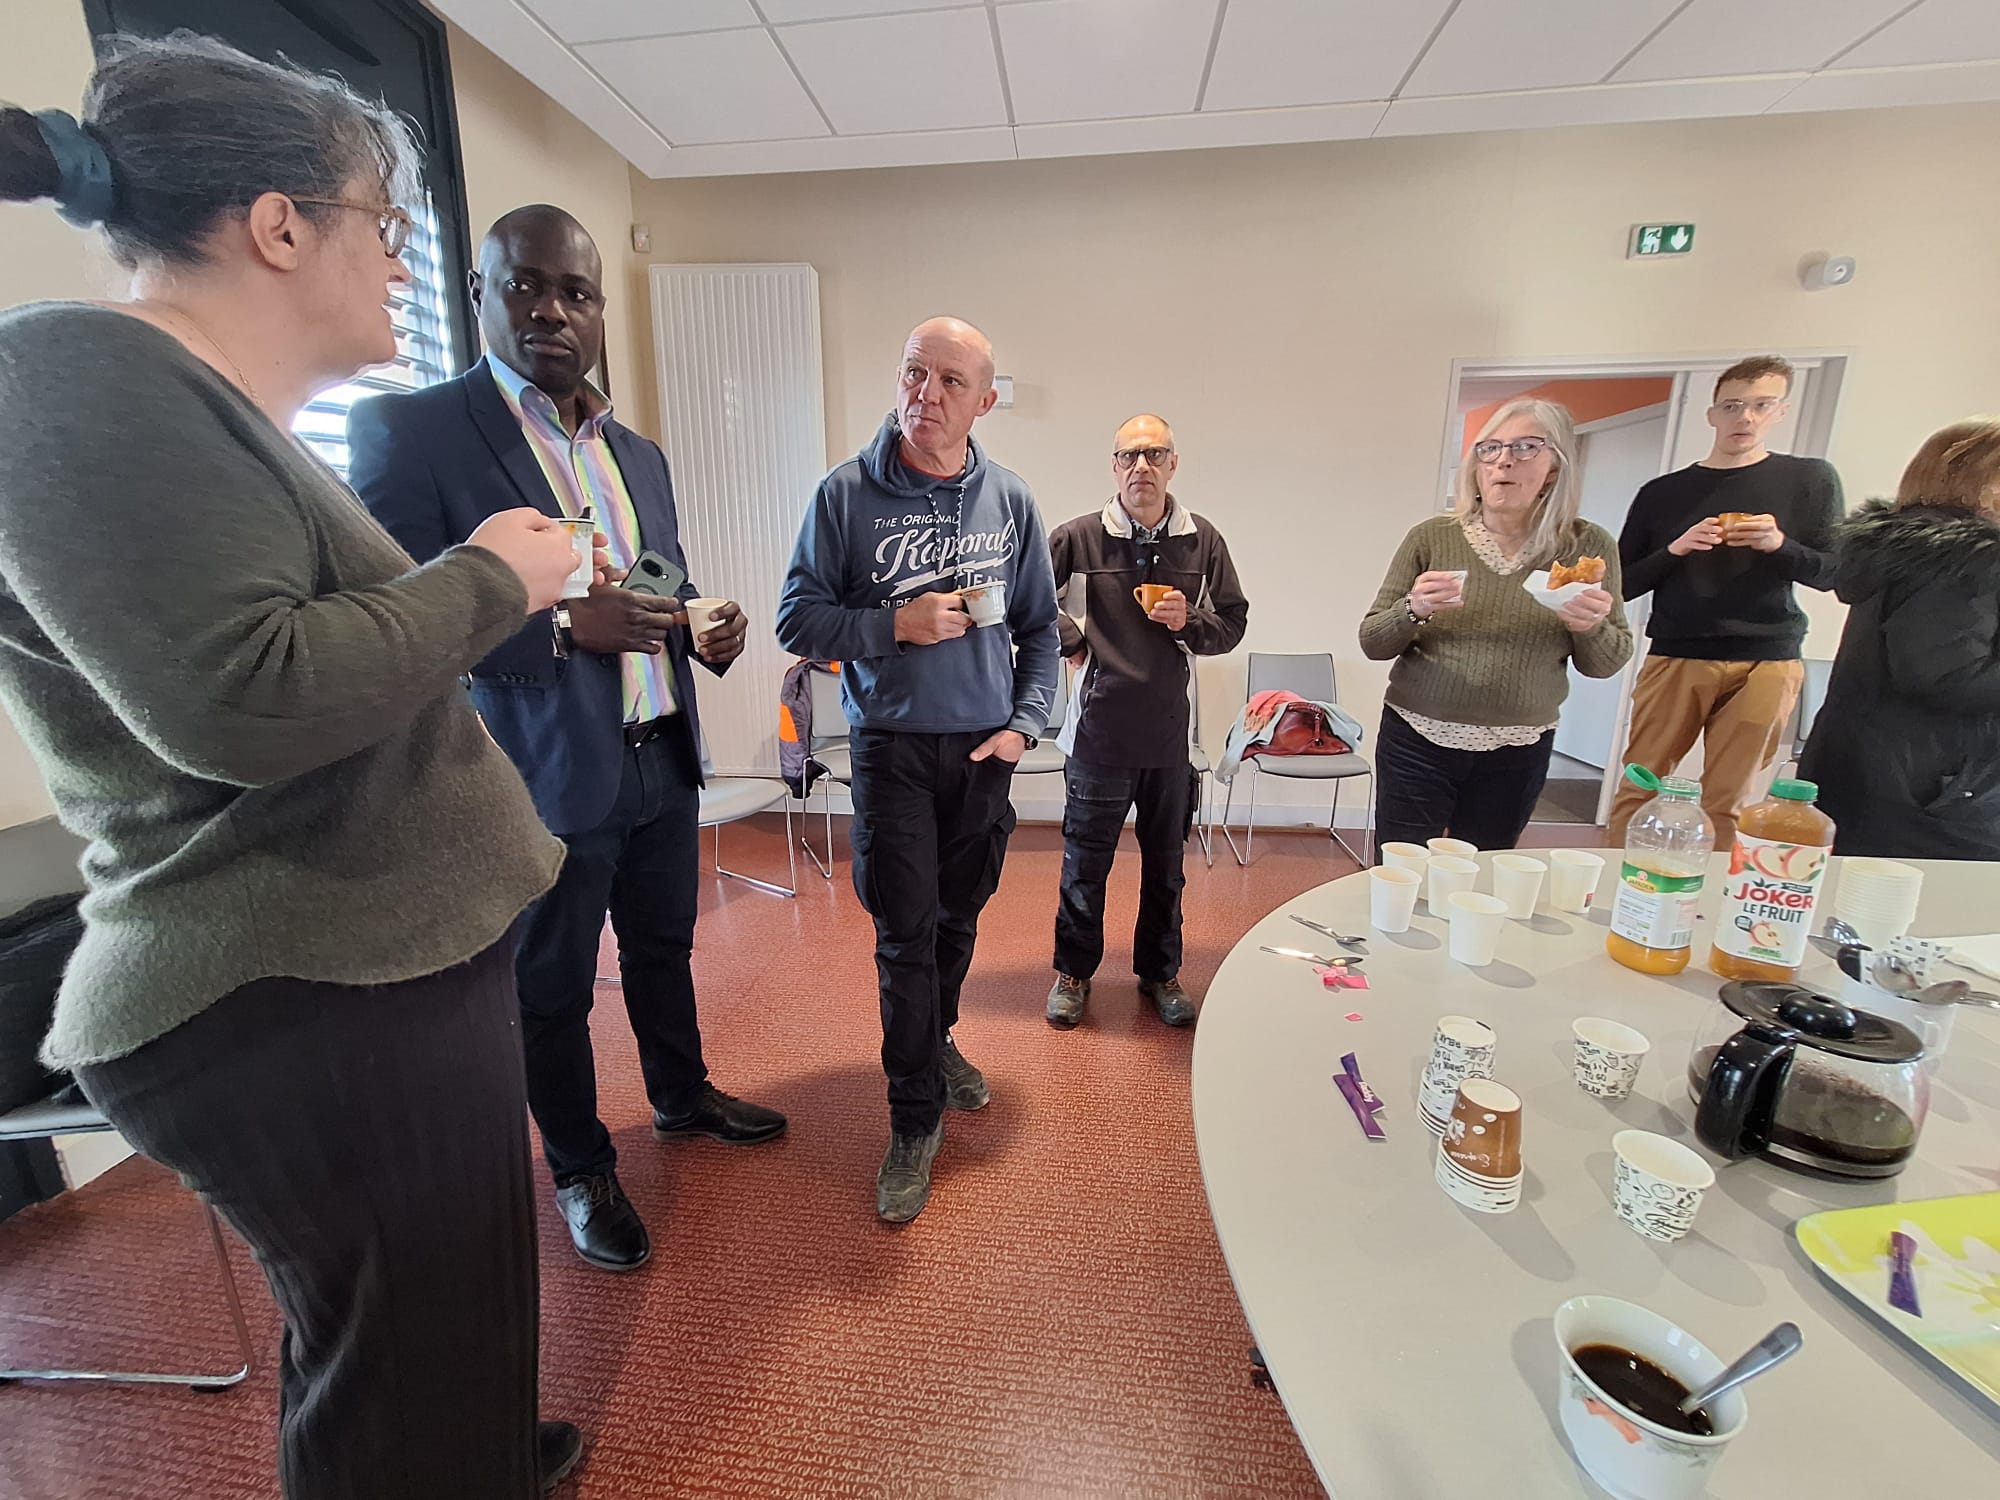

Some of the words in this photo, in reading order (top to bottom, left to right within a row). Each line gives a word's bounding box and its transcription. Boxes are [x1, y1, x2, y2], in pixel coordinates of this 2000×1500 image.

[874, 517, 898, 530] THE
[871, 519, 1014, 584] Kaporal
[1743, 902, 1757, 915] LE
